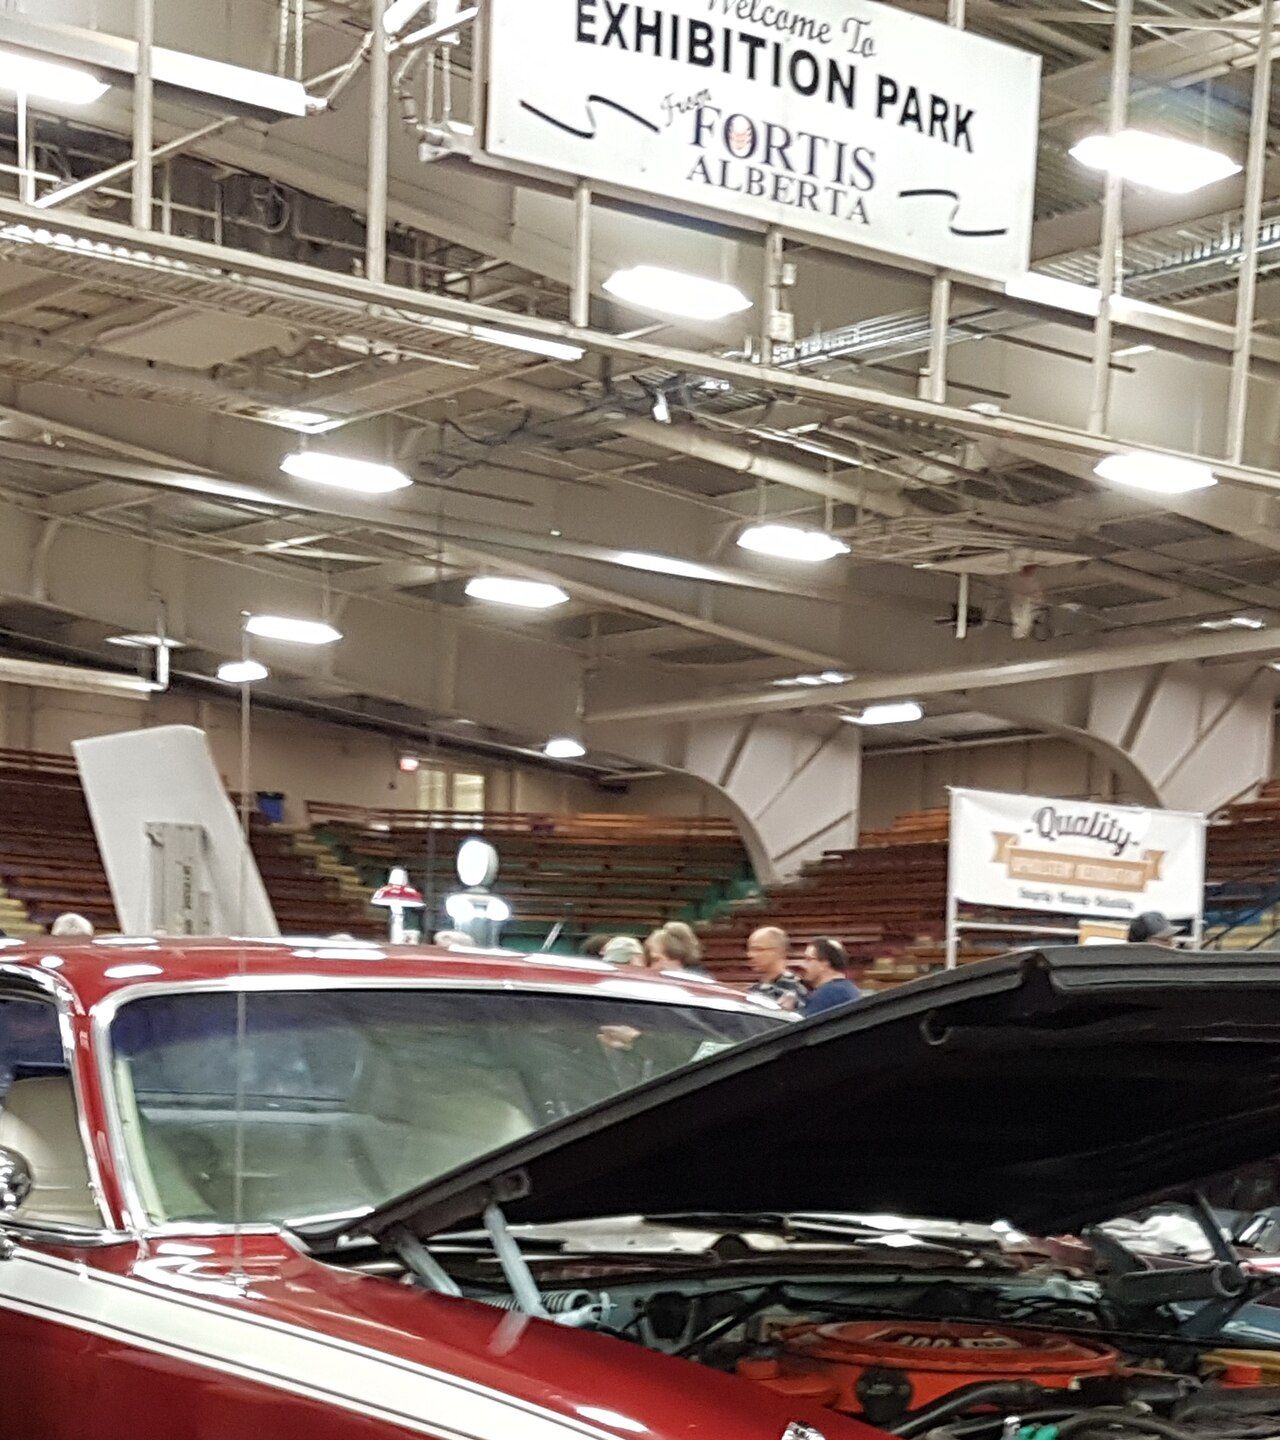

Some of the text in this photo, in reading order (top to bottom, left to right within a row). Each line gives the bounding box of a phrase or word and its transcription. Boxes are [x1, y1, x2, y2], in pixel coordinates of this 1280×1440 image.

[842, 17, 876, 57] To
[577, 0, 975, 153] EXHIBITION PARK
[690, 106, 876, 191] FORTIS
[686, 155, 870, 225] ALBERTA
[1035, 806, 1132, 856] Quality
